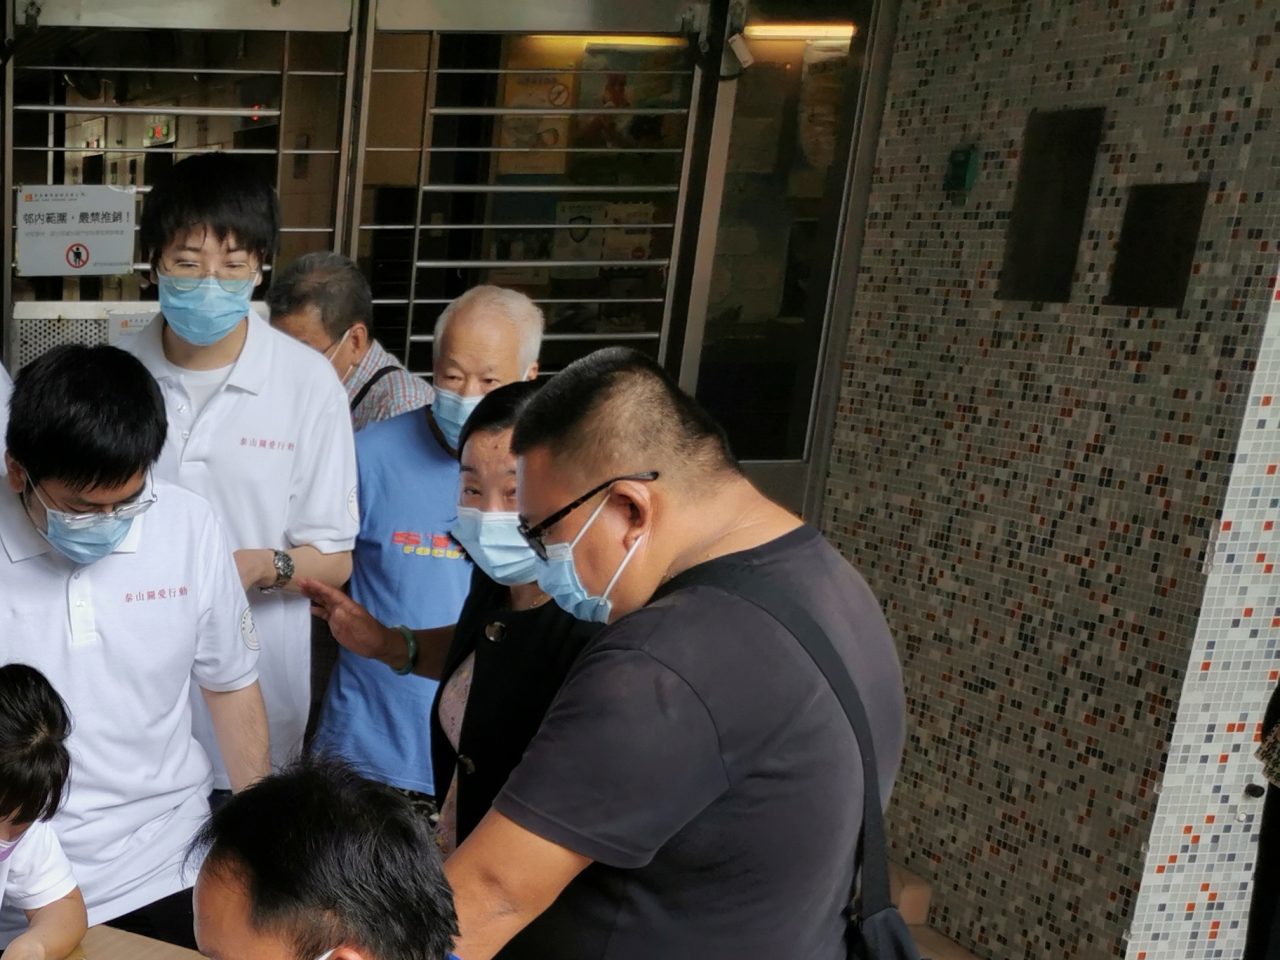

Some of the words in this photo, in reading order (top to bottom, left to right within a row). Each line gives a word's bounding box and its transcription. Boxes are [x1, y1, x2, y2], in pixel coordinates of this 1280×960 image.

[125, 585, 188, 603] 泰山關愛行動
